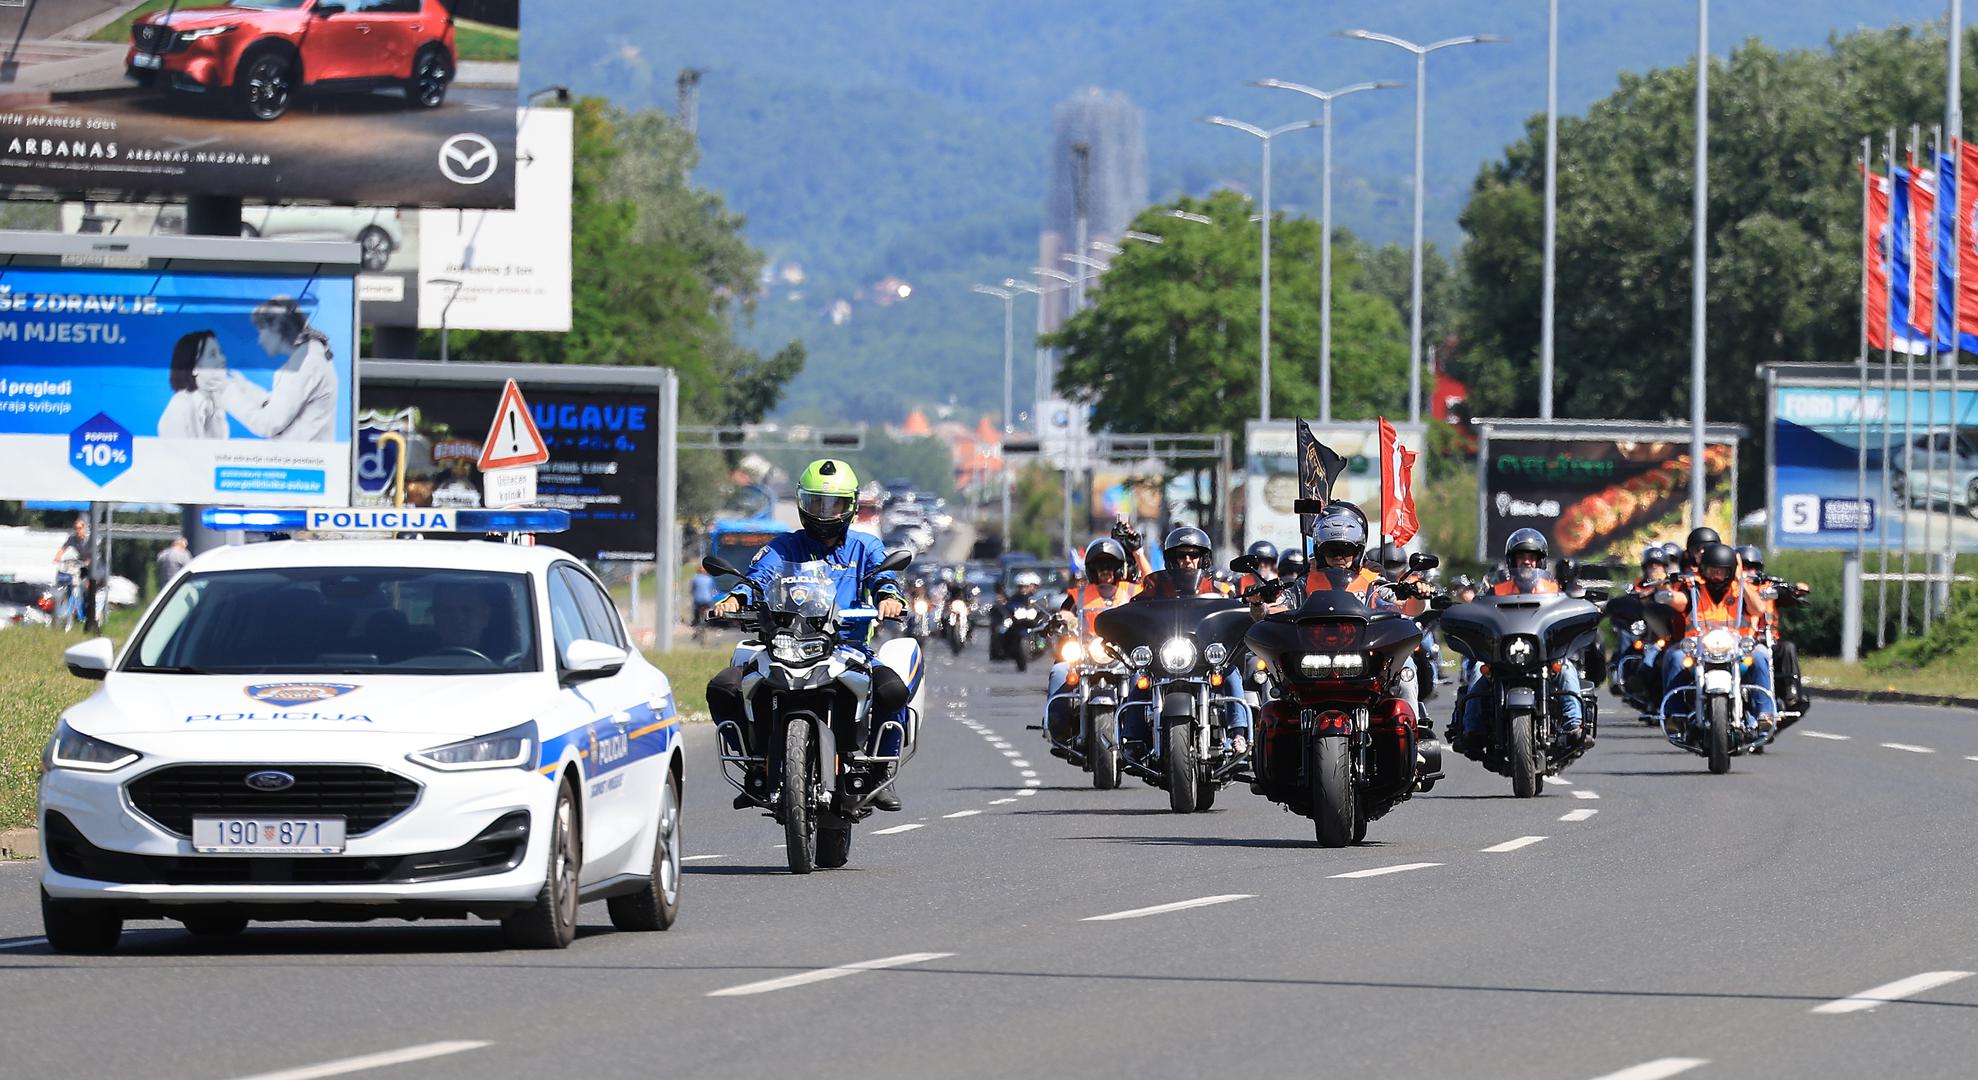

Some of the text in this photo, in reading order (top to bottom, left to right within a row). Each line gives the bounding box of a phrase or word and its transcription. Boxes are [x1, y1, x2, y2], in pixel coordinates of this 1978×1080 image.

[26, 114, 81, 129] JAPANESE
[86, 117, 117, 130] SOUL
[8, 137, 118, 159] ARBANAS
[33, 294, 164, 315] ZDRAVLJE.
[24, 322, 126, 345] MJESTU.
[9, 380, 72, 398] pregledi
[28, 400, 72, 415] svibnja
[525, 403, 647, 431] UGAVE
[76, 443, 127, 466] -10%
[313, 512, 448, 530] POLICIJA
[1793, 502, 1808, 526] 5
[781, 576, 819, 584] POLICIJA
[184, 712, 374, 723] POLICIJA
[217, 821, 322, 845] 190 871
